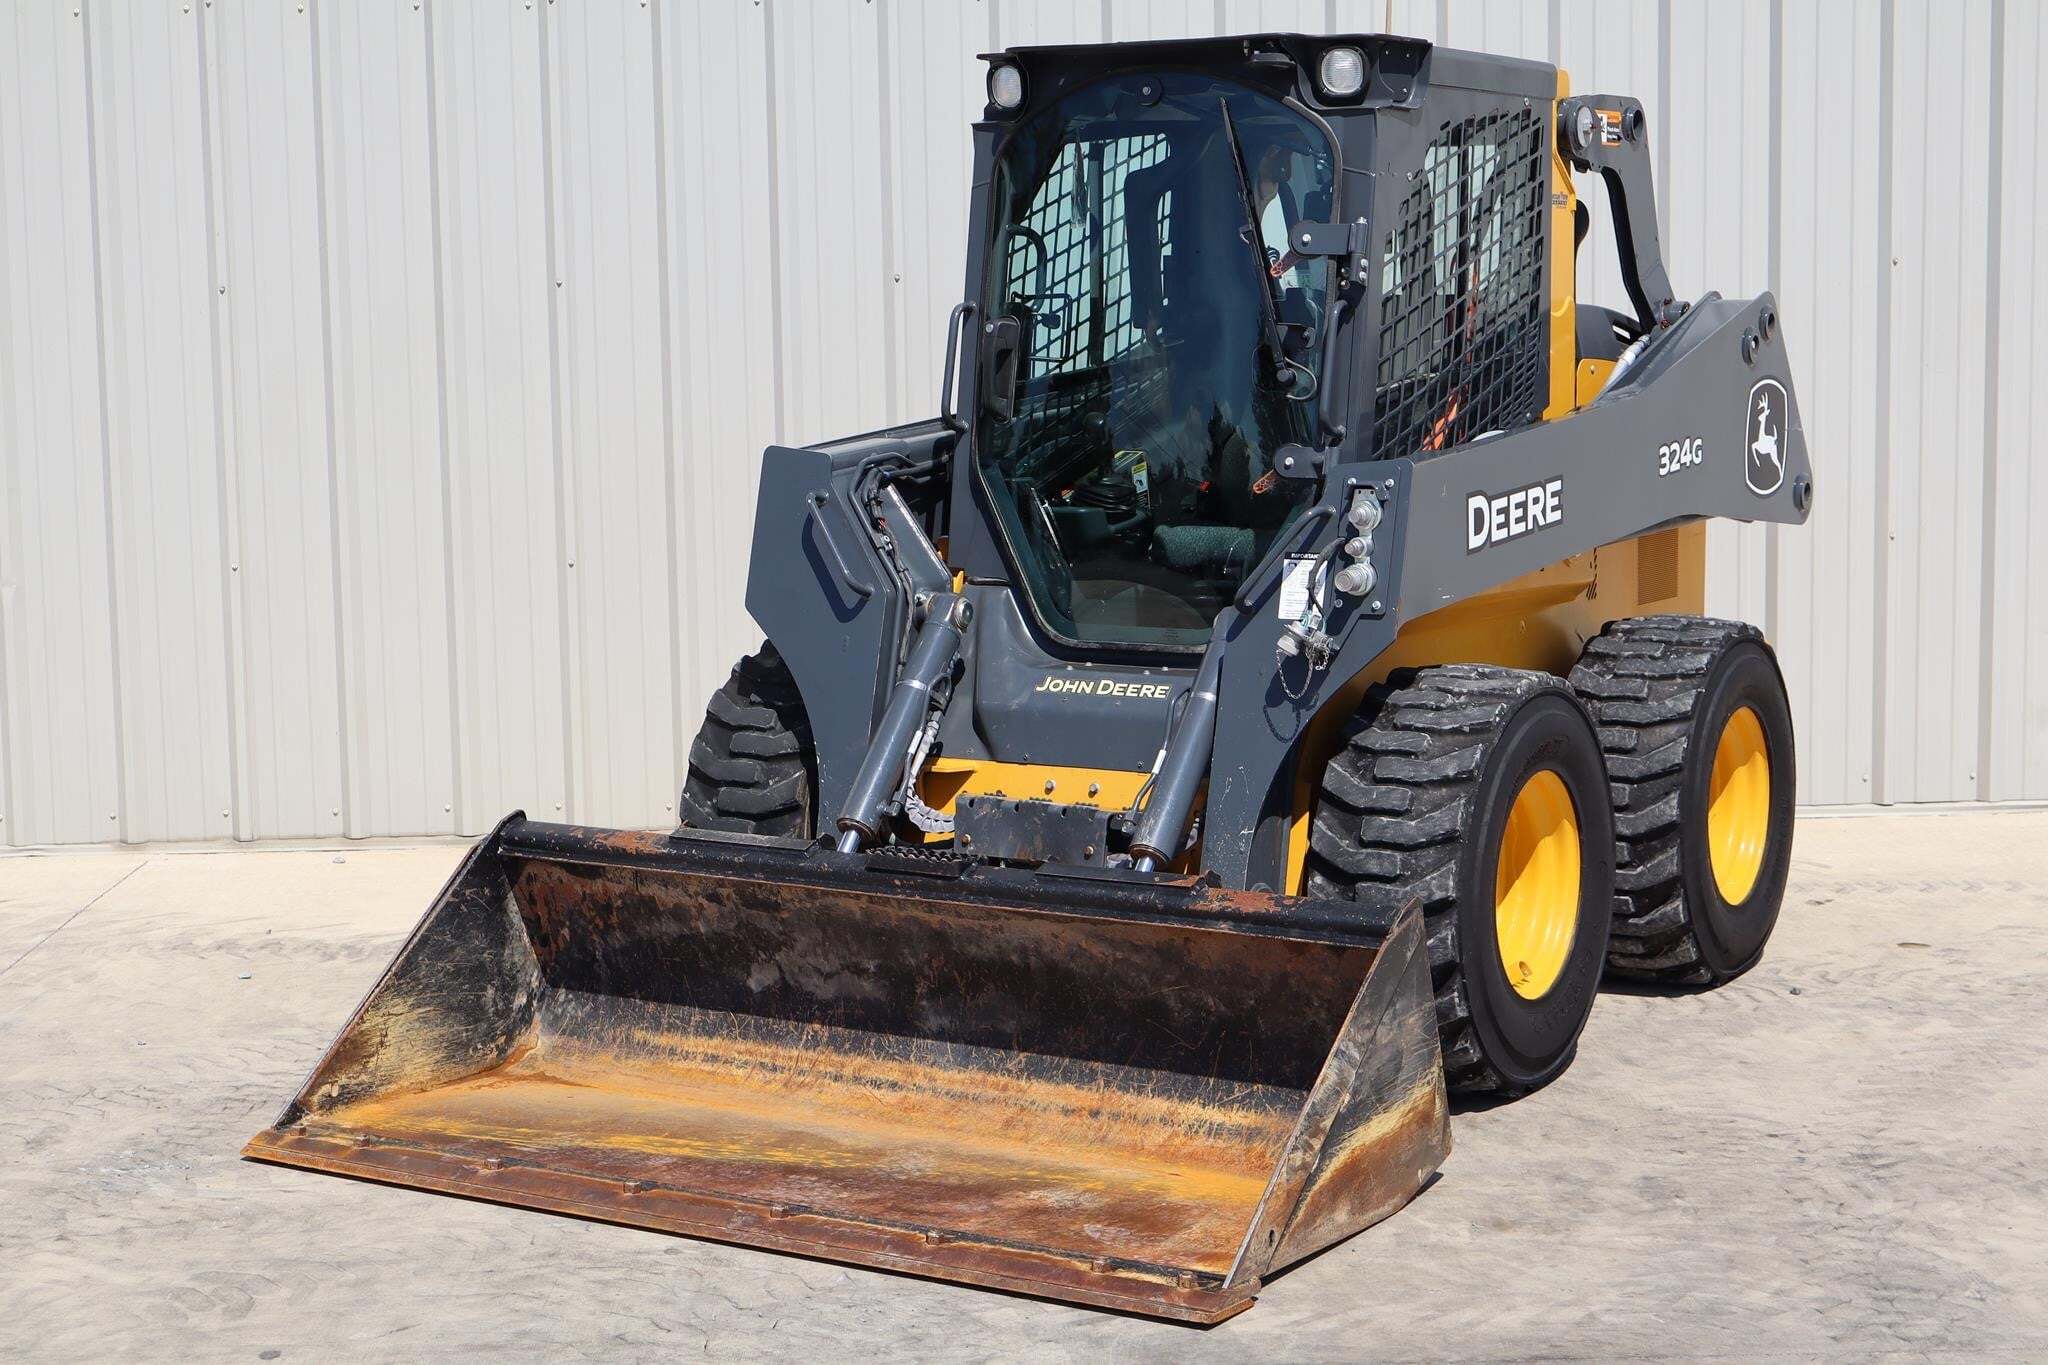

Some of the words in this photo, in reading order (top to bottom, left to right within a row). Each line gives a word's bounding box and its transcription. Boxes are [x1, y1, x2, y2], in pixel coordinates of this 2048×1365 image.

[1659, 438, 1703, 476] 324G
[1468, 479, 1562, 550] DEERE
[1035, 676, 1095, 694] JOHN
[1096, 679, 1170, 699] DEERE
